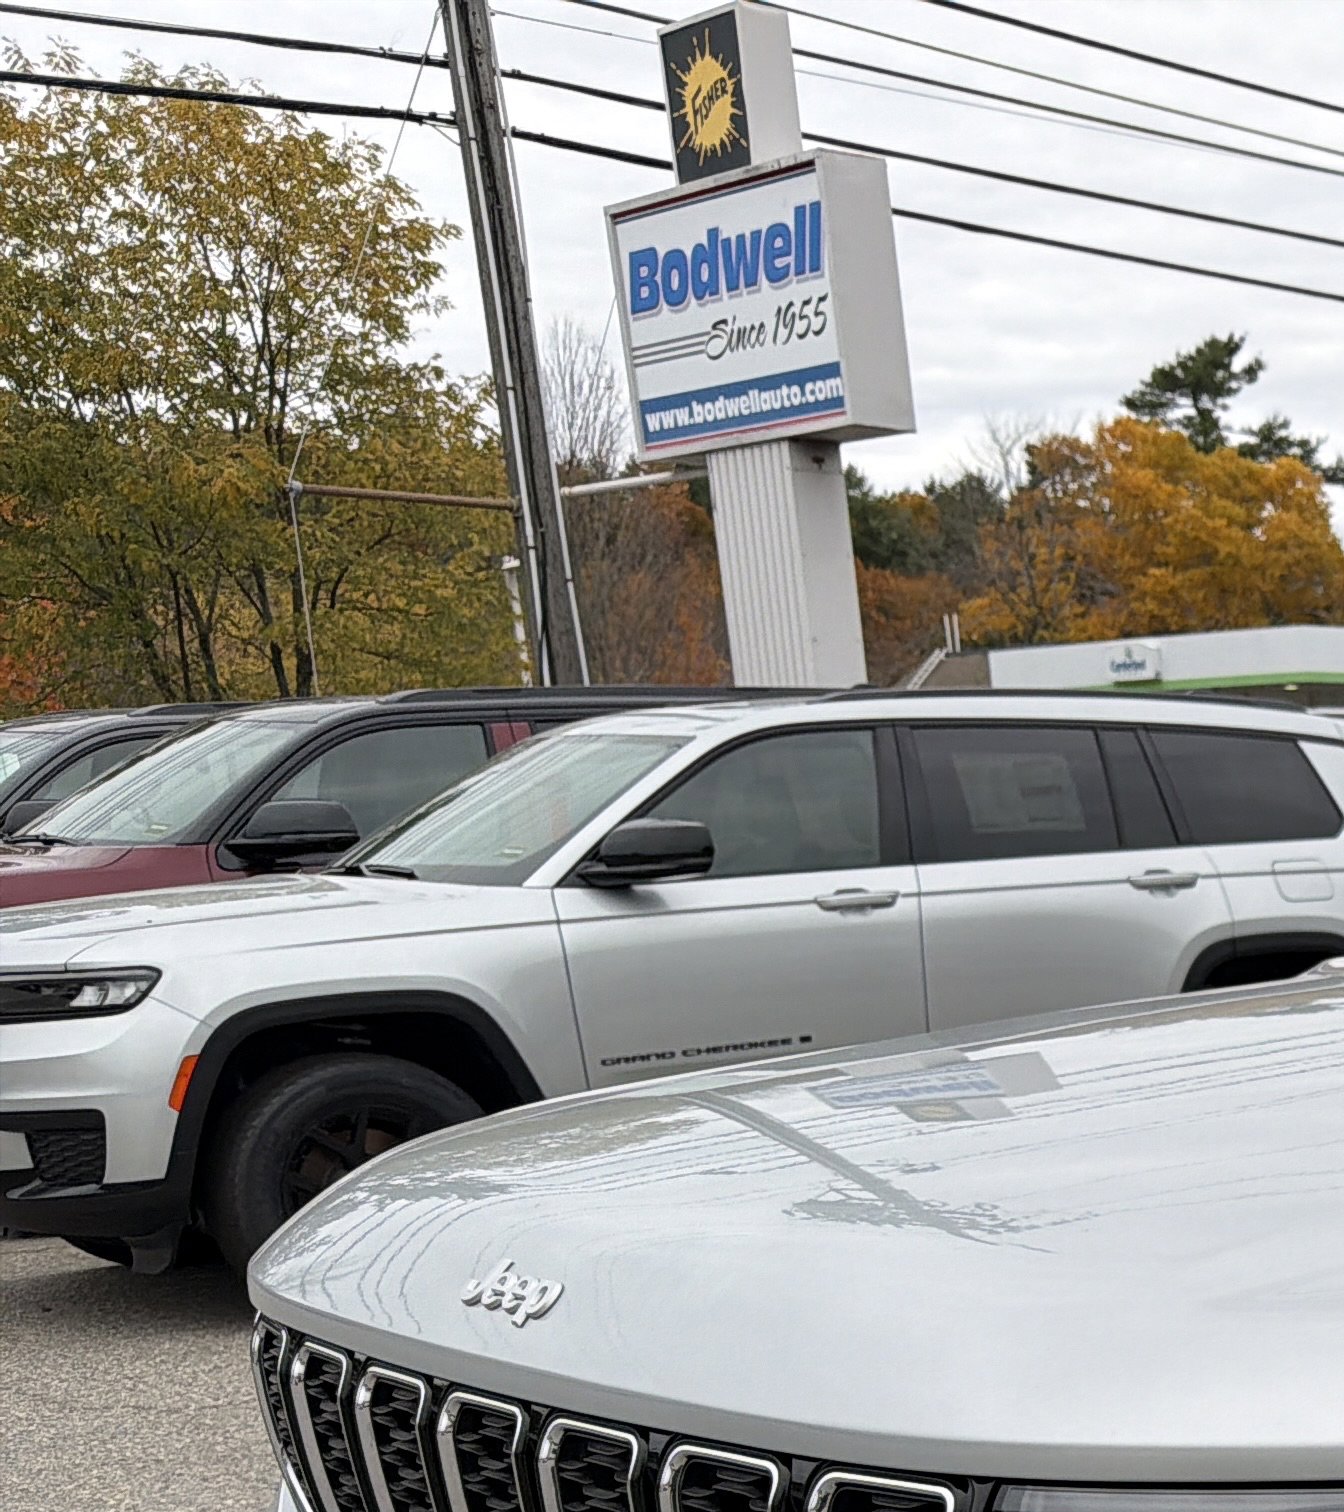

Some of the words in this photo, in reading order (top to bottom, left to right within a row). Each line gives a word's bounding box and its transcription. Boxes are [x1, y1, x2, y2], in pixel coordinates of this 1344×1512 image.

[692, 77, 729, 133] FISHER
[629, 200, 823, 316] Bodwell
[704, 315, 767, 361] Since
[772, 292, 829, 347] 1955
[645, 375, 844, 433] www.bodwellauto.com
[601, 1051, 675, 1067] GRAND
[681, 1037, 793, 1058] CHEROKEE
[460, 1258, 565, 1329] Jeep
